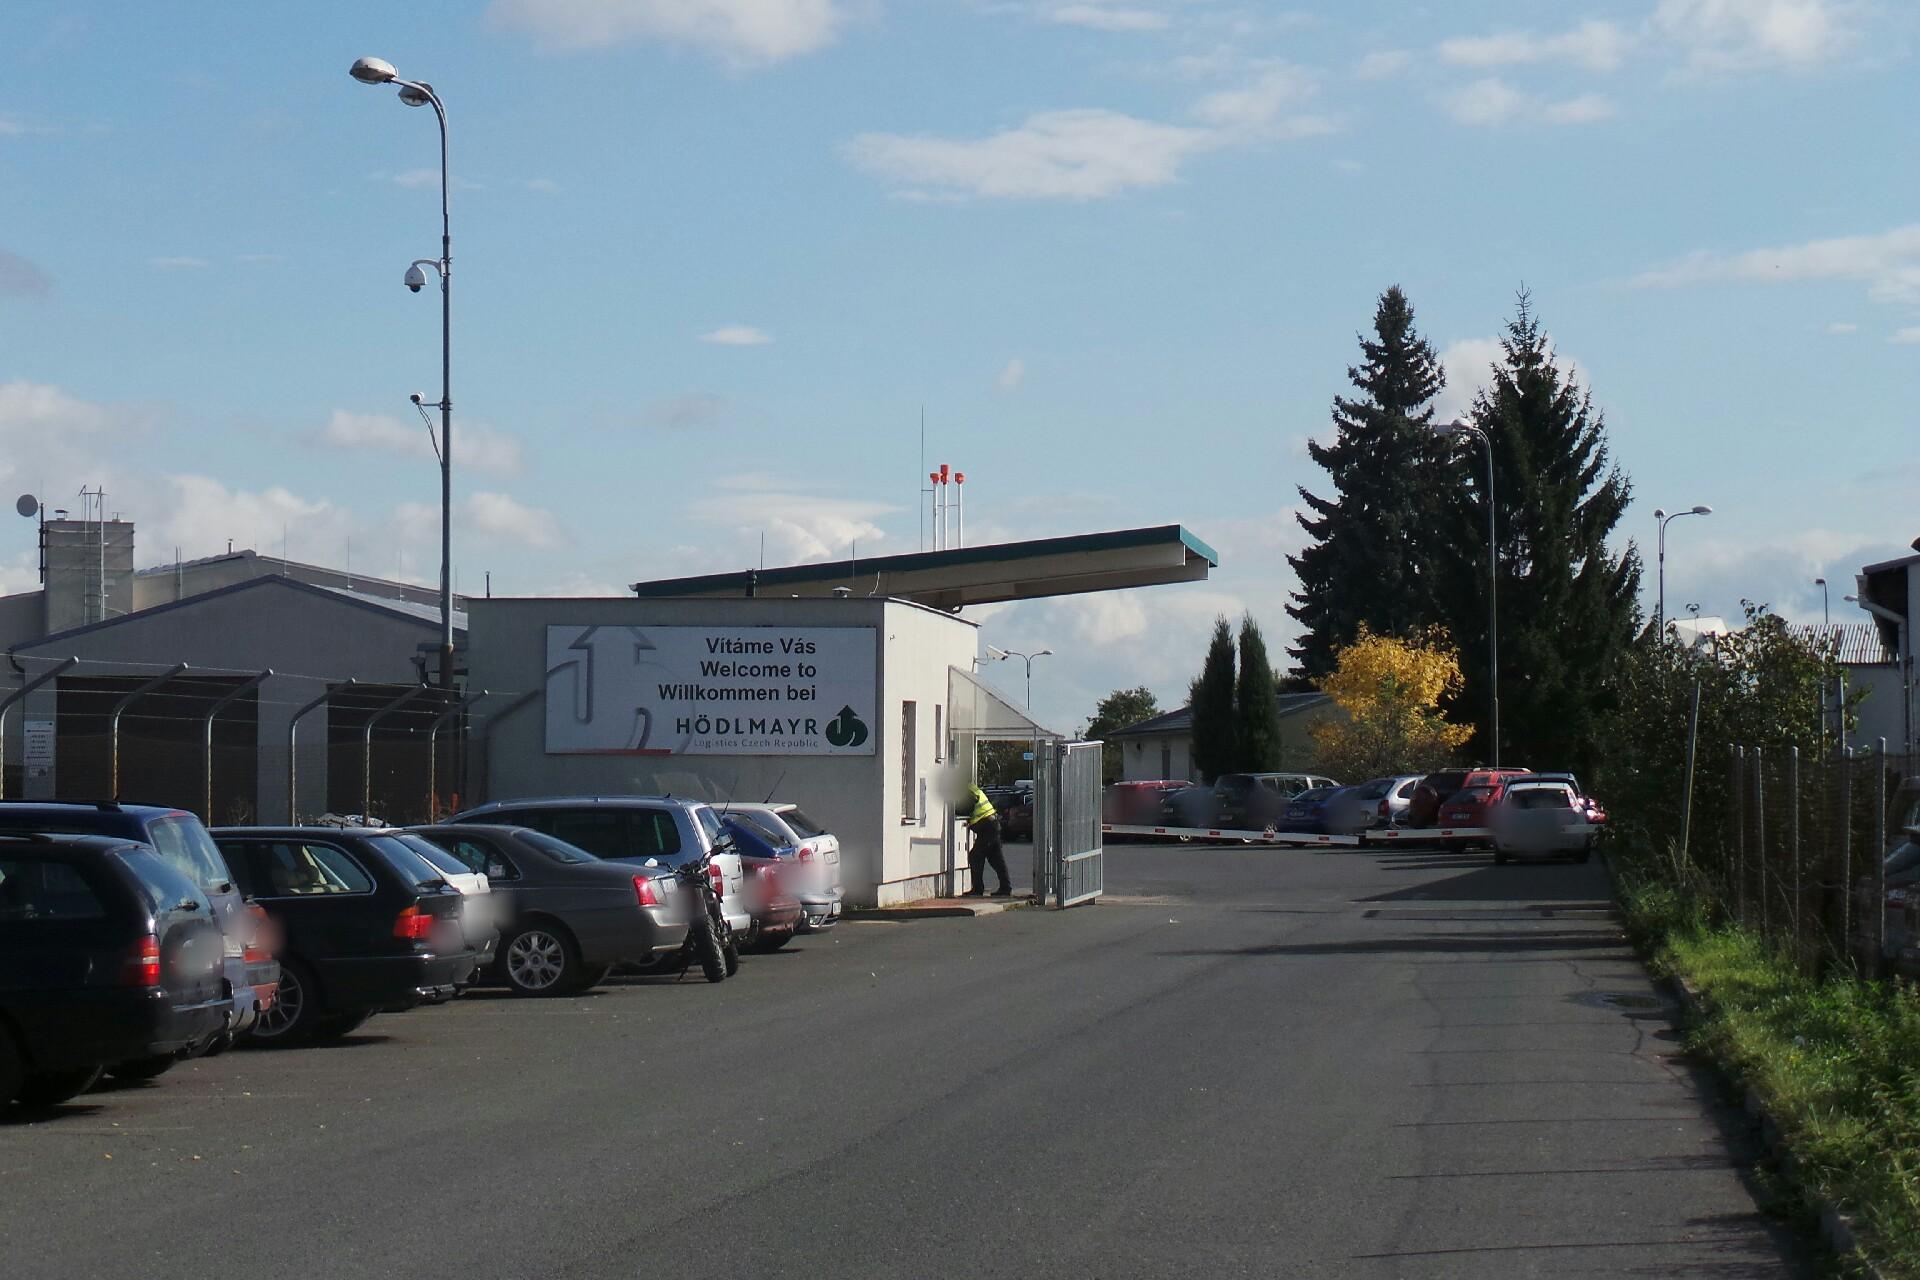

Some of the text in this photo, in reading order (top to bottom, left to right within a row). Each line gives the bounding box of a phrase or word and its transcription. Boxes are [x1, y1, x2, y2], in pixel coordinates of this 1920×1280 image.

[706, 637, 816, 654] Vítáme Vás
[700, 661, 817, 677] Welcome to
[658, 684, 816, 700] Willkommen bei
[676, 714, 818, 735] HÖDLMAYR
[694, 738, 818, 748] Logistics Czech Republic
